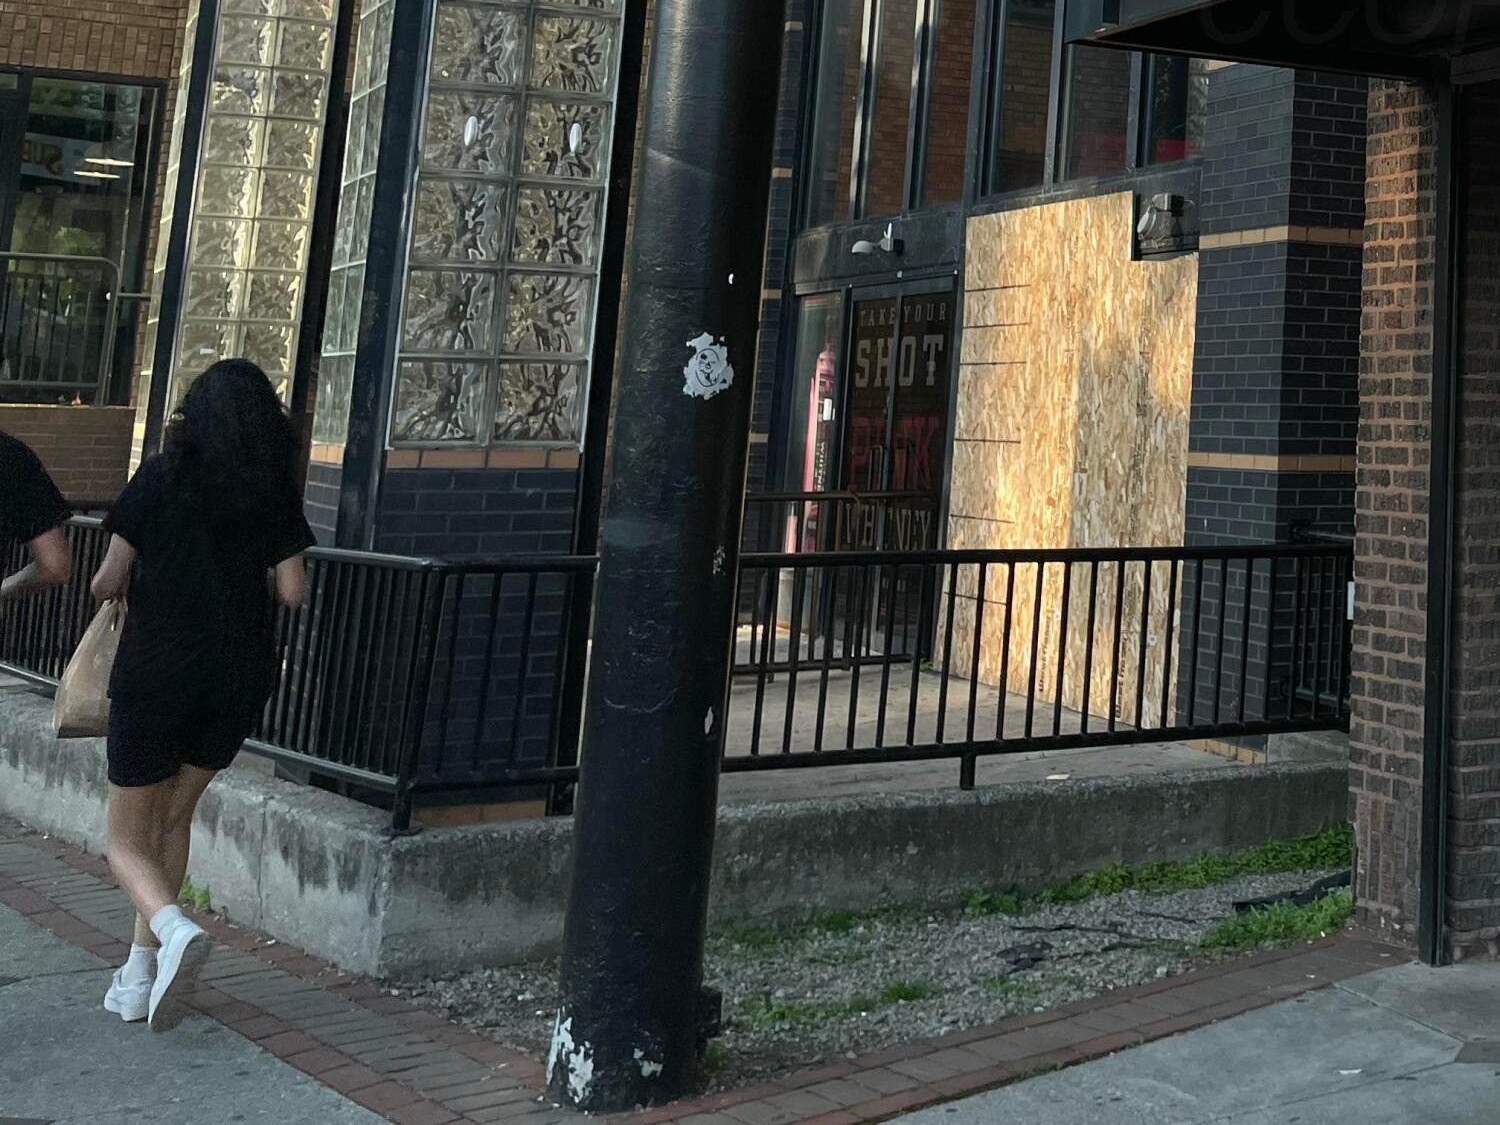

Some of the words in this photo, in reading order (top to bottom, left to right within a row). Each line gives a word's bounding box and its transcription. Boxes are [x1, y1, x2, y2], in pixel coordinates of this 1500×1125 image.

[860, 307, 897, 329] TAKE
[903, 302, 948, 325] YOUR
[855, 334, 944, 389] SHOT
